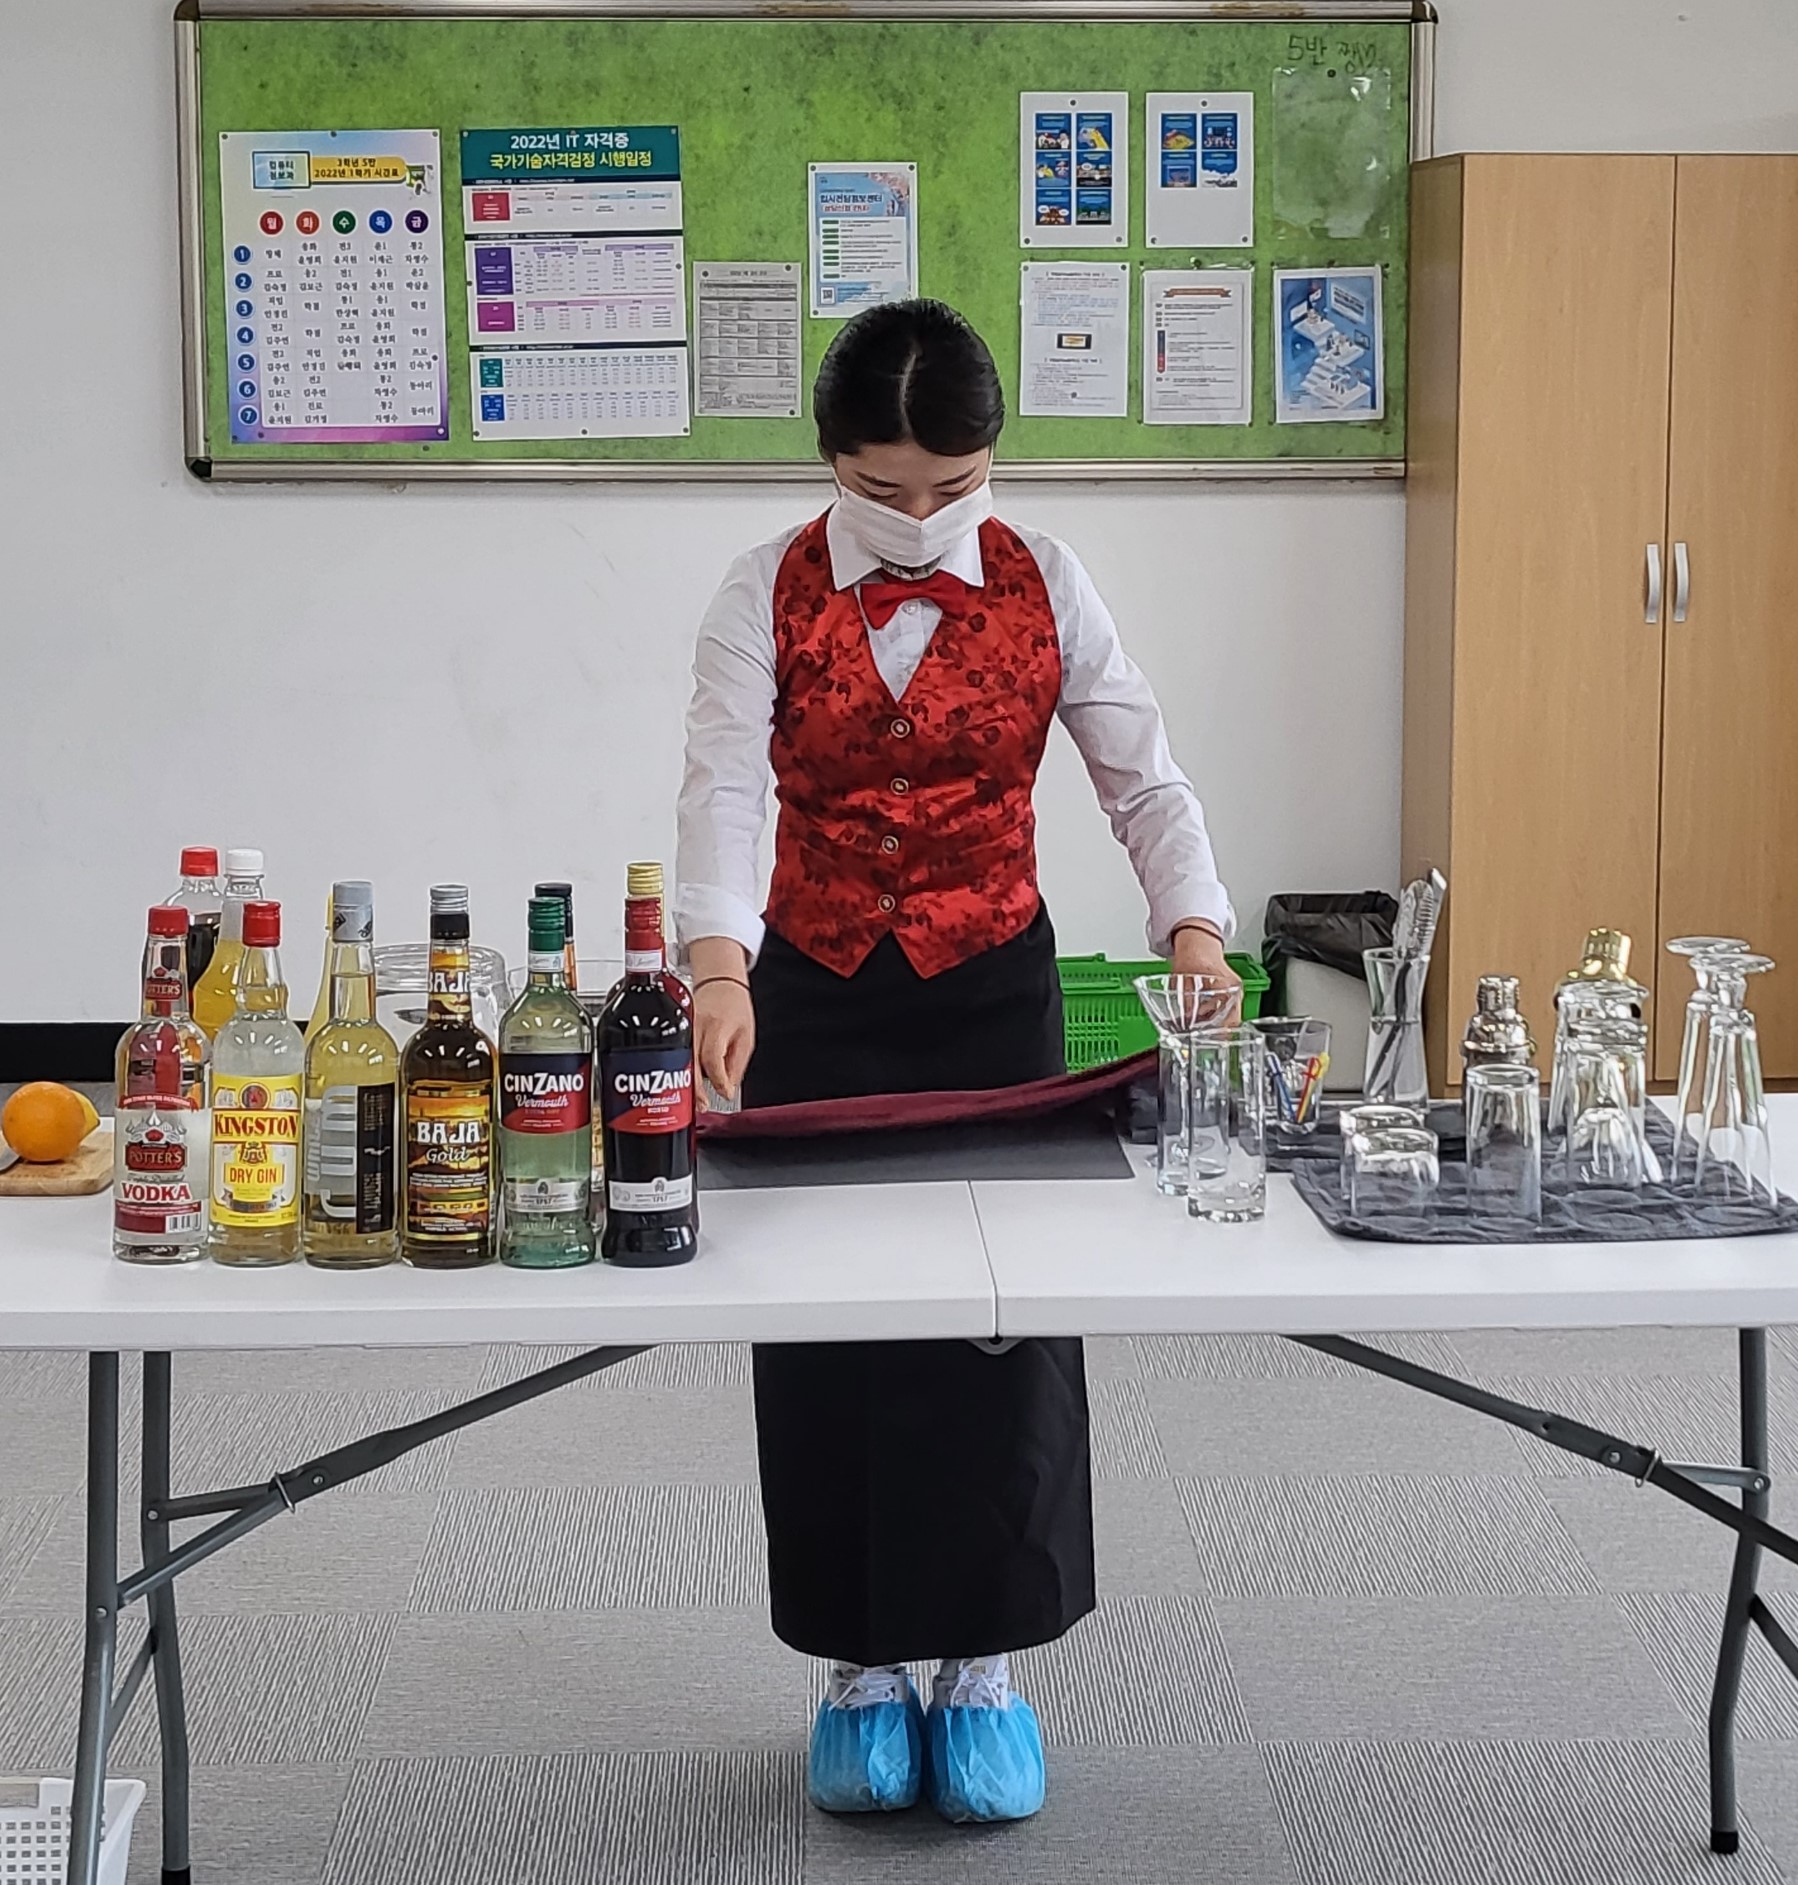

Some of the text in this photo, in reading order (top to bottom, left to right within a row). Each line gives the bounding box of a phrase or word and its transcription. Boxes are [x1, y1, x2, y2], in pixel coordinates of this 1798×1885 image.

[1288, 35, 1328, 66] 5반
[510, 132, 630, 150] 2022년 IT 자격증
[490, 150, 653, 170] 국가기술자격검정 시행일정
[338, 217, 351, 229] 수
[504, 1072, 584, 1095] CINZANO
[614, 1070, 691, 1094] CINZANO
[515, 1094, 569, 1107] Vermouth
[630, 1091, 681, 1107] Vermouth
[214, 1114, 299, 1138] KINGSTON
[417, 1121, 480, 1144] BAJA
[426, 1145, 468, 1163] Gold
[230, 1168, 276, 1184] DRY GIN
[122, 1183, 190, 1201] VODKA
